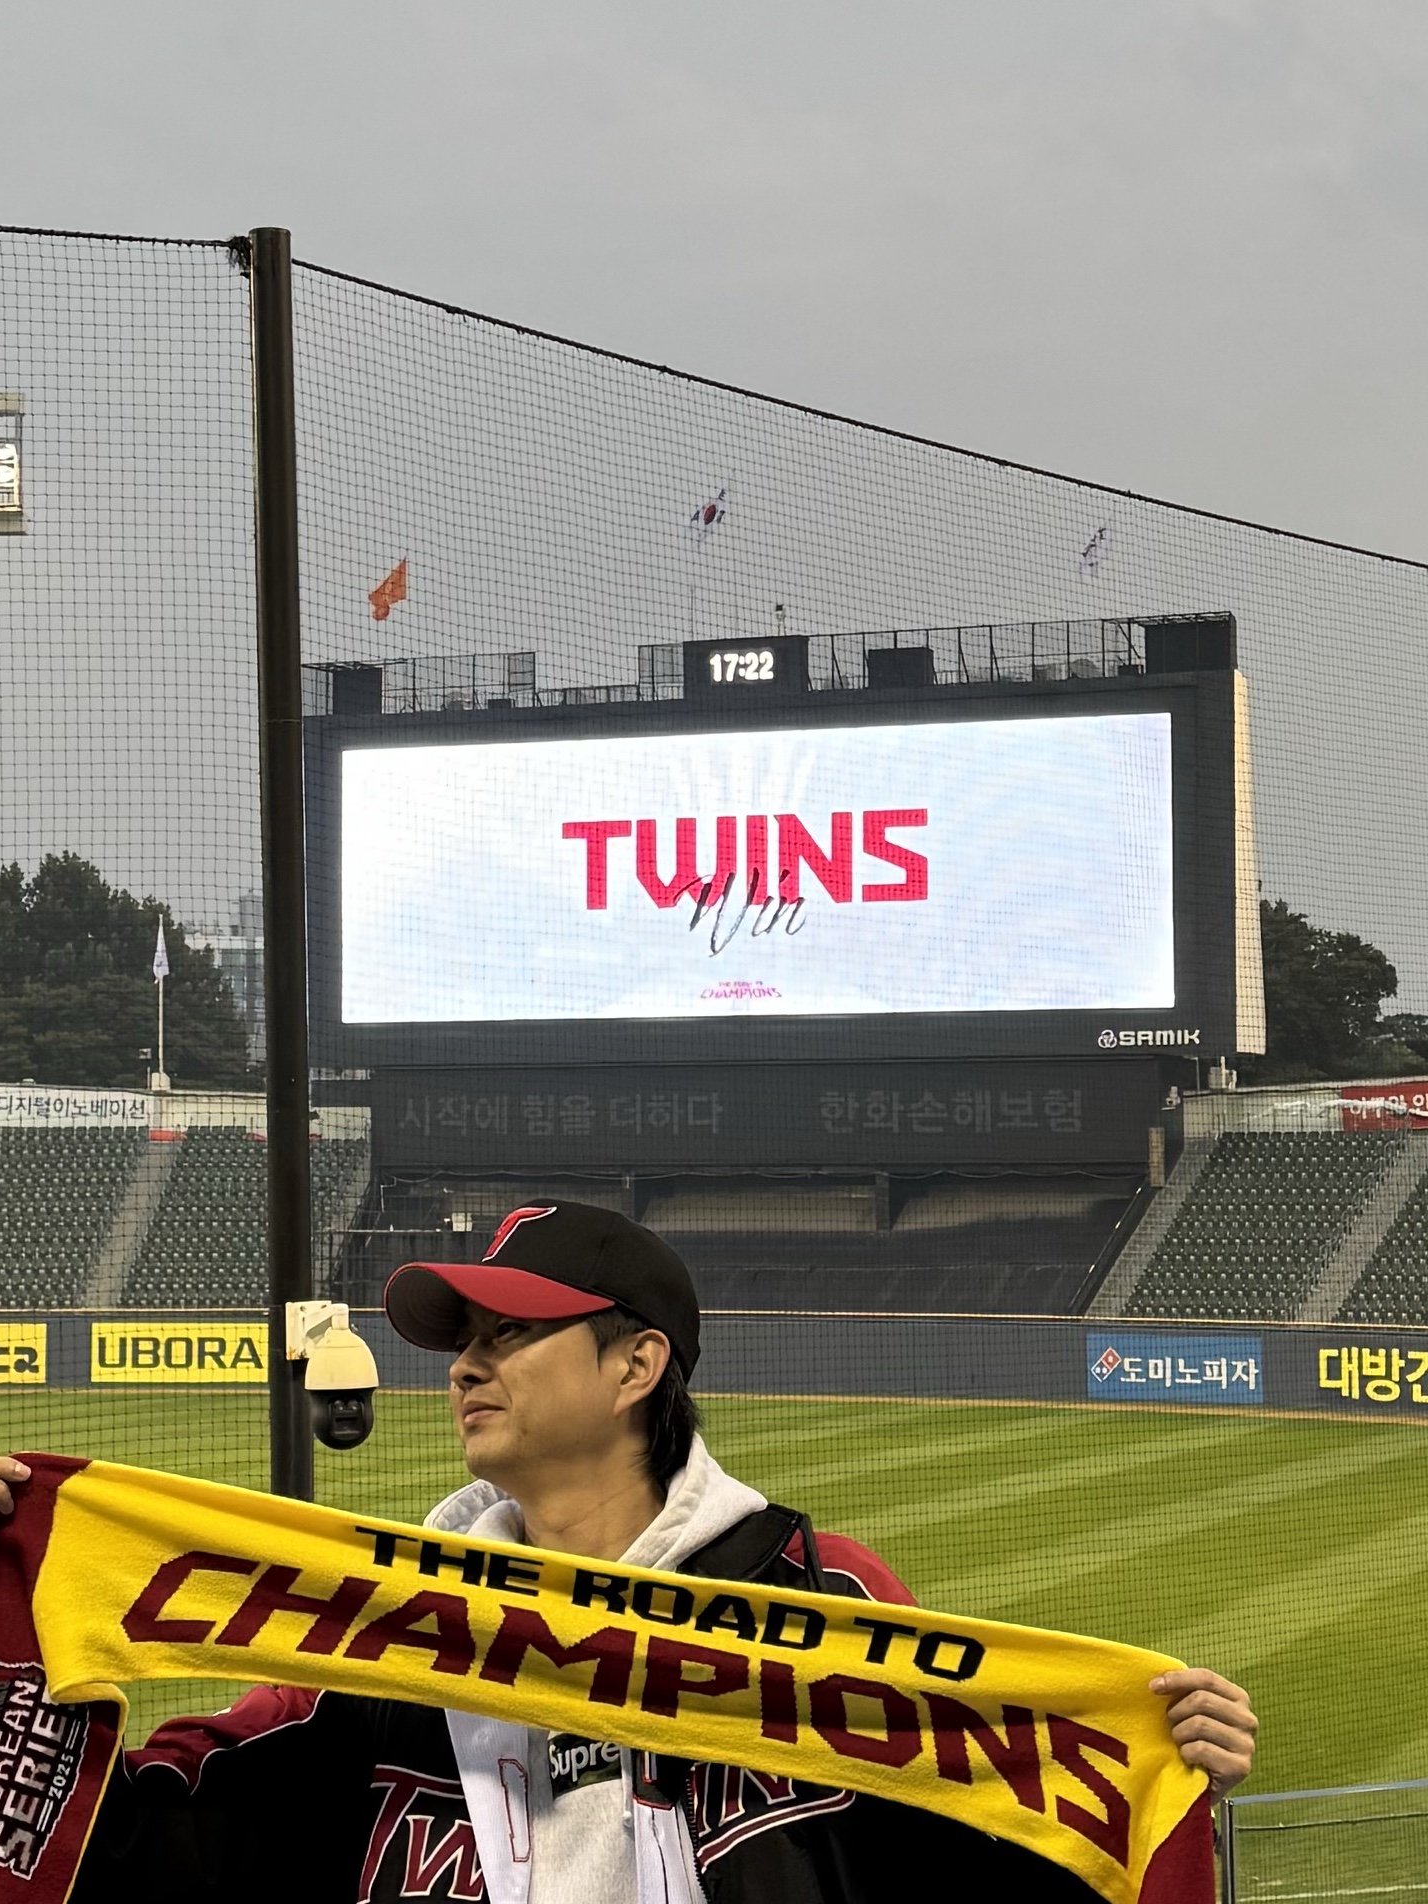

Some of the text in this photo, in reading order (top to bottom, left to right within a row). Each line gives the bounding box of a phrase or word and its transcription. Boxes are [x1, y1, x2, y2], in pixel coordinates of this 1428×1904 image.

[709, 649, 774, 684] 17:22
[562, 808, 928, 911] TWINS
[674, 866, 806, 957] Win
[398, 1093, 723, 1137] 시작에 힘을 더하다
[821, 1089, 1082, 1133] 한화손해보험
[98, 1336, 264, 1369] UBORA
[1120, 1354, 1259, 1390] 도미노피자
[354, 1525, 985, 1681] THE ROAD TO
[121, 1550, 1131, 1870] CHAMPIONS
[48, 1753, 74, 1800] 2025
[548, 1741, 621, 1783] Supre
